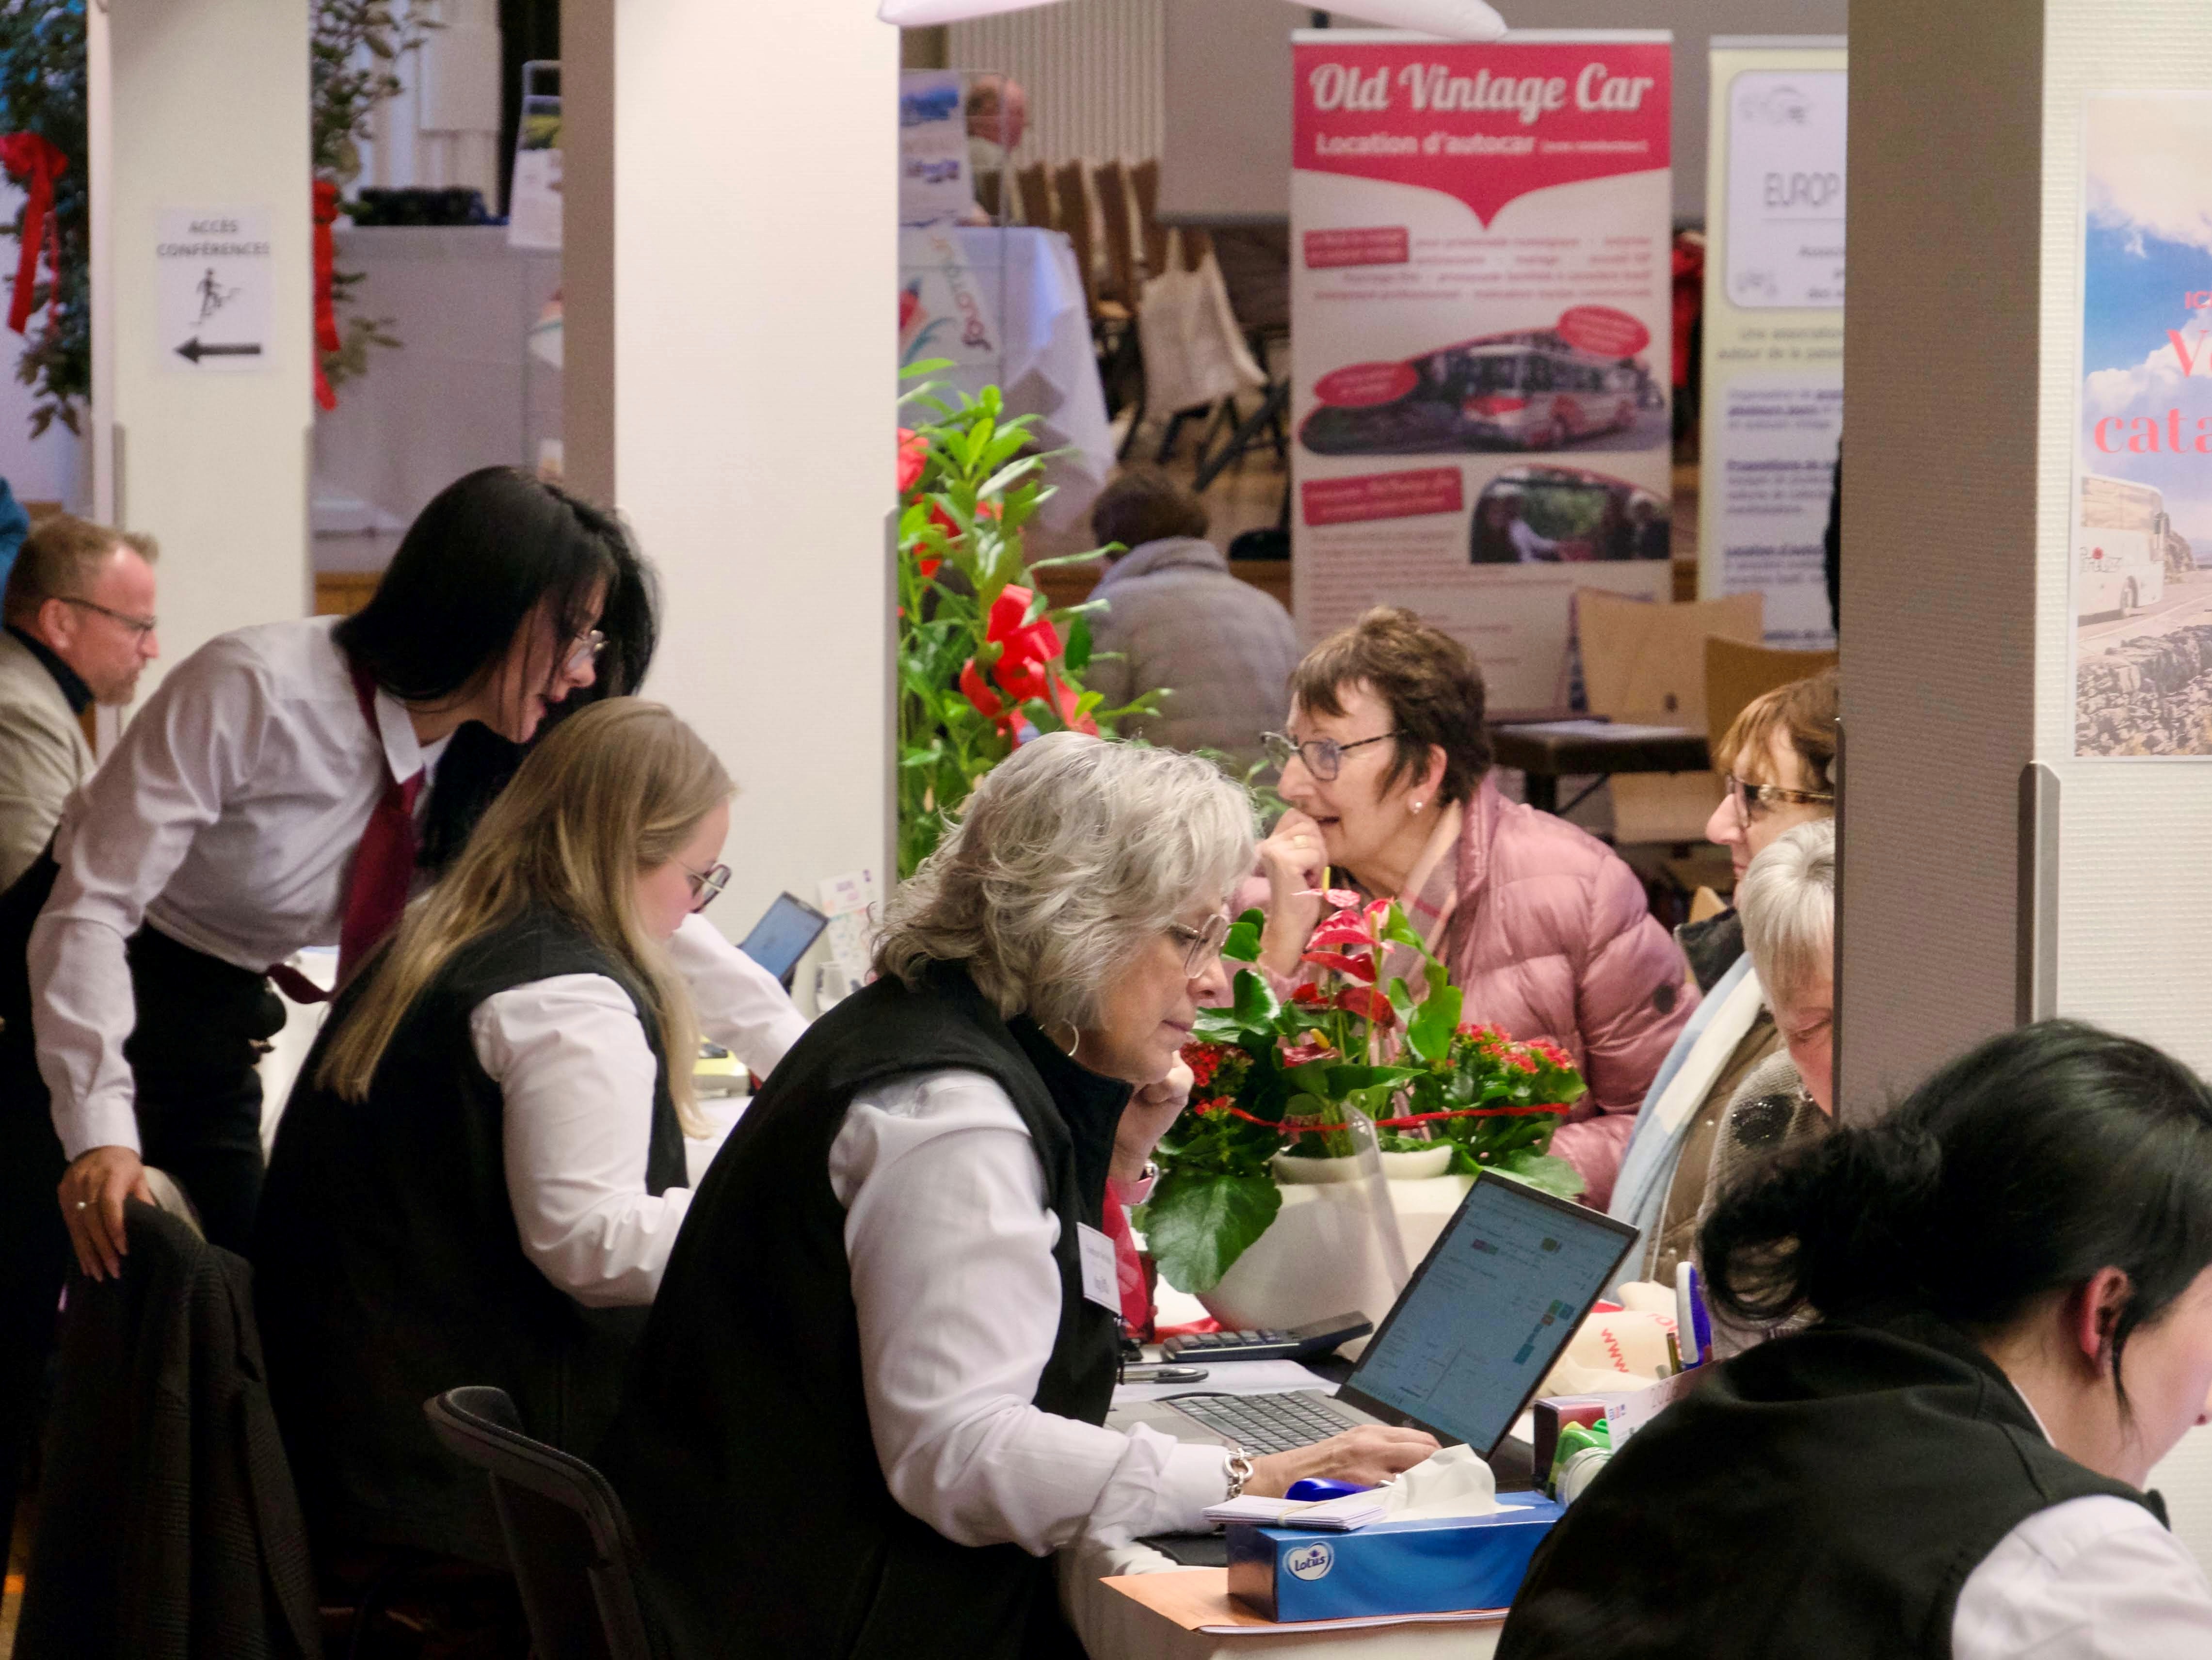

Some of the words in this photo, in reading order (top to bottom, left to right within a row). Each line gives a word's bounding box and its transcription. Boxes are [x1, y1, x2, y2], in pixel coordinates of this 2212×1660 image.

[1309, 63, 1389, 111] Old
[1397, 63, 1567, 125] Vintage
[1576, 62, 1654, 111] Car
[1315, 131, 1418, 155] Location
[1422, 131, 1534, 155] d'autocar
[1764, 172, 1841, 207] EUROP
[2184, 291, 2212, 309] IC
[2165, 329, 2212, 379] V
[1295, 1556, 1325, 1571] Lotus
